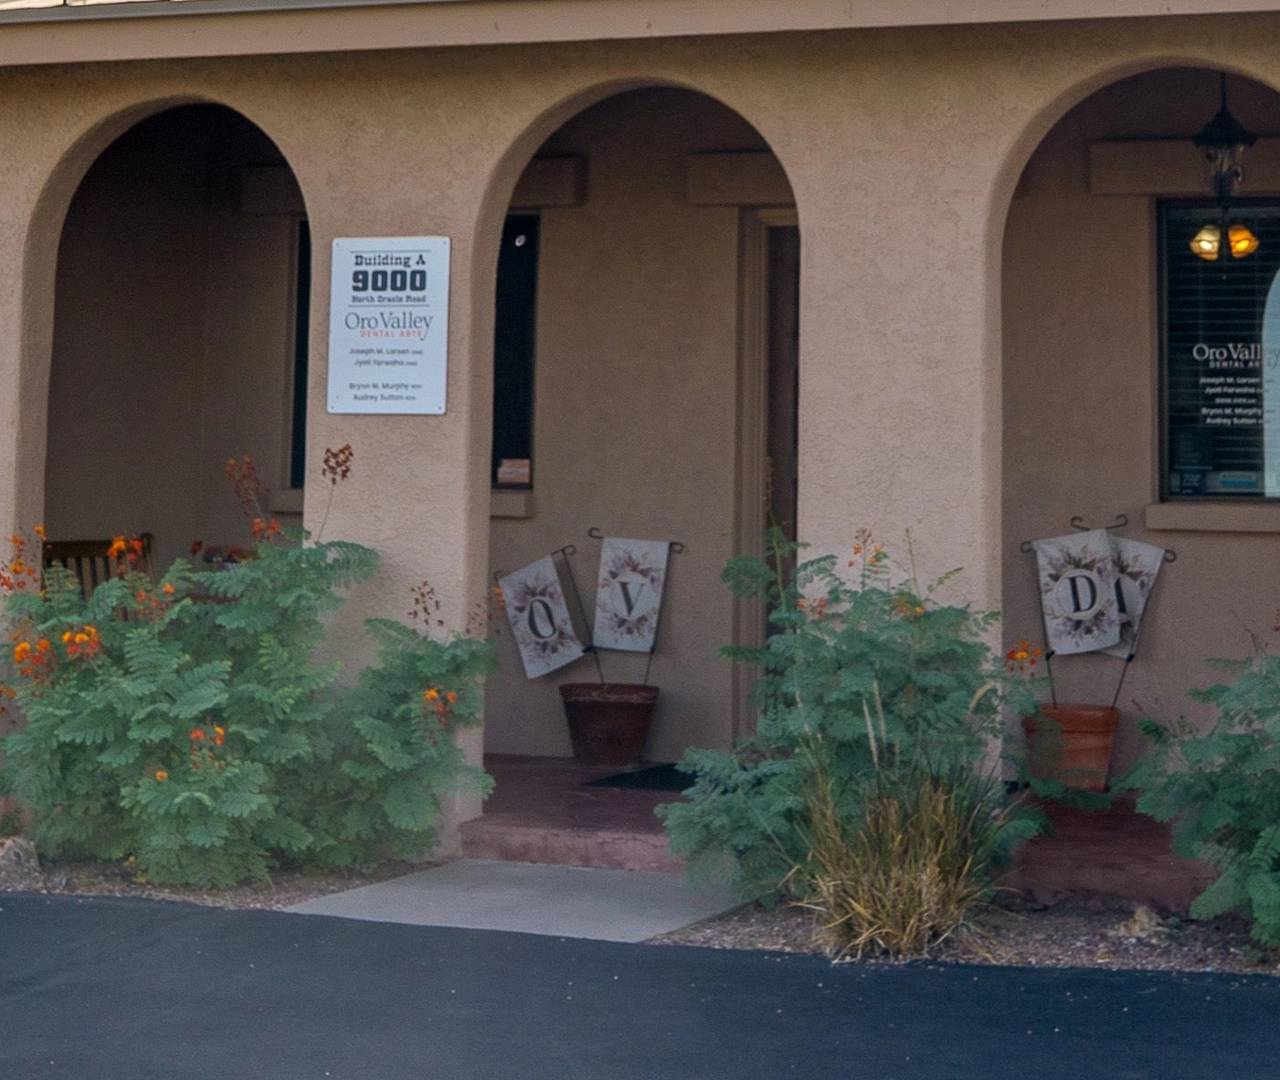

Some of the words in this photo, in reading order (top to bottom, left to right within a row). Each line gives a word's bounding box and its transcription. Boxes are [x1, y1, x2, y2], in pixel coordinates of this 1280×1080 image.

[354, 253, 411, 269] Building
[416, 253, 426, 266] A
[351, 269, 427, 292] 9000
[351, 295, 376, 303] North
[344, 311, 379, 331] Oro
[380, 311, 434, 341] Valley
[360, 330, 395, 338] DENTAL
[400, 330, 423, 338] ARTS
[1192, 343, 1228, 361] Oro
[620, 581, 645, 617] V
[1068, 574, 1098, 614] D
